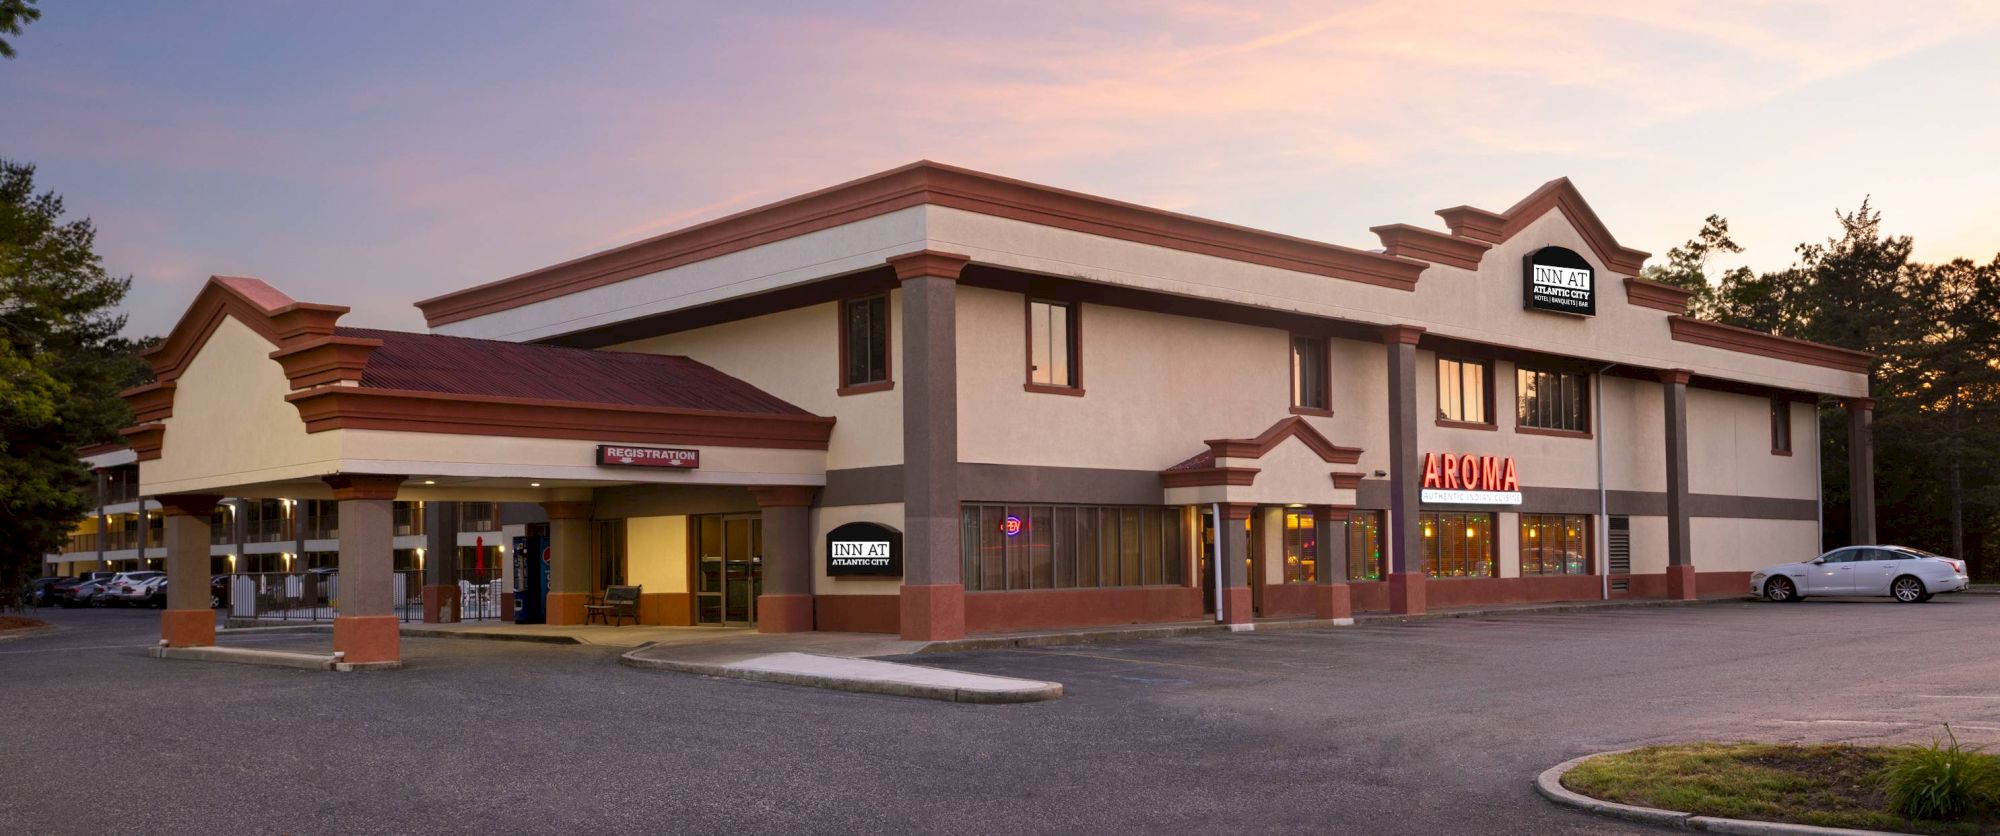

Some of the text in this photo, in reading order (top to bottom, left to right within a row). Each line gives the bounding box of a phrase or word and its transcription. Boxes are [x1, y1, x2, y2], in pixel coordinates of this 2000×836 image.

[1535, 267, 1588, 287] INN AT
[1534, 286, 1590, 300] ATLANTIC CITY
[1552, 297, 1576, 305] BANQUETS
[607, 448, 695, 460] REGISTRATION
[1423, 452, 1519, 491] AROMA
[834, 543, 888, 556] INN AT
